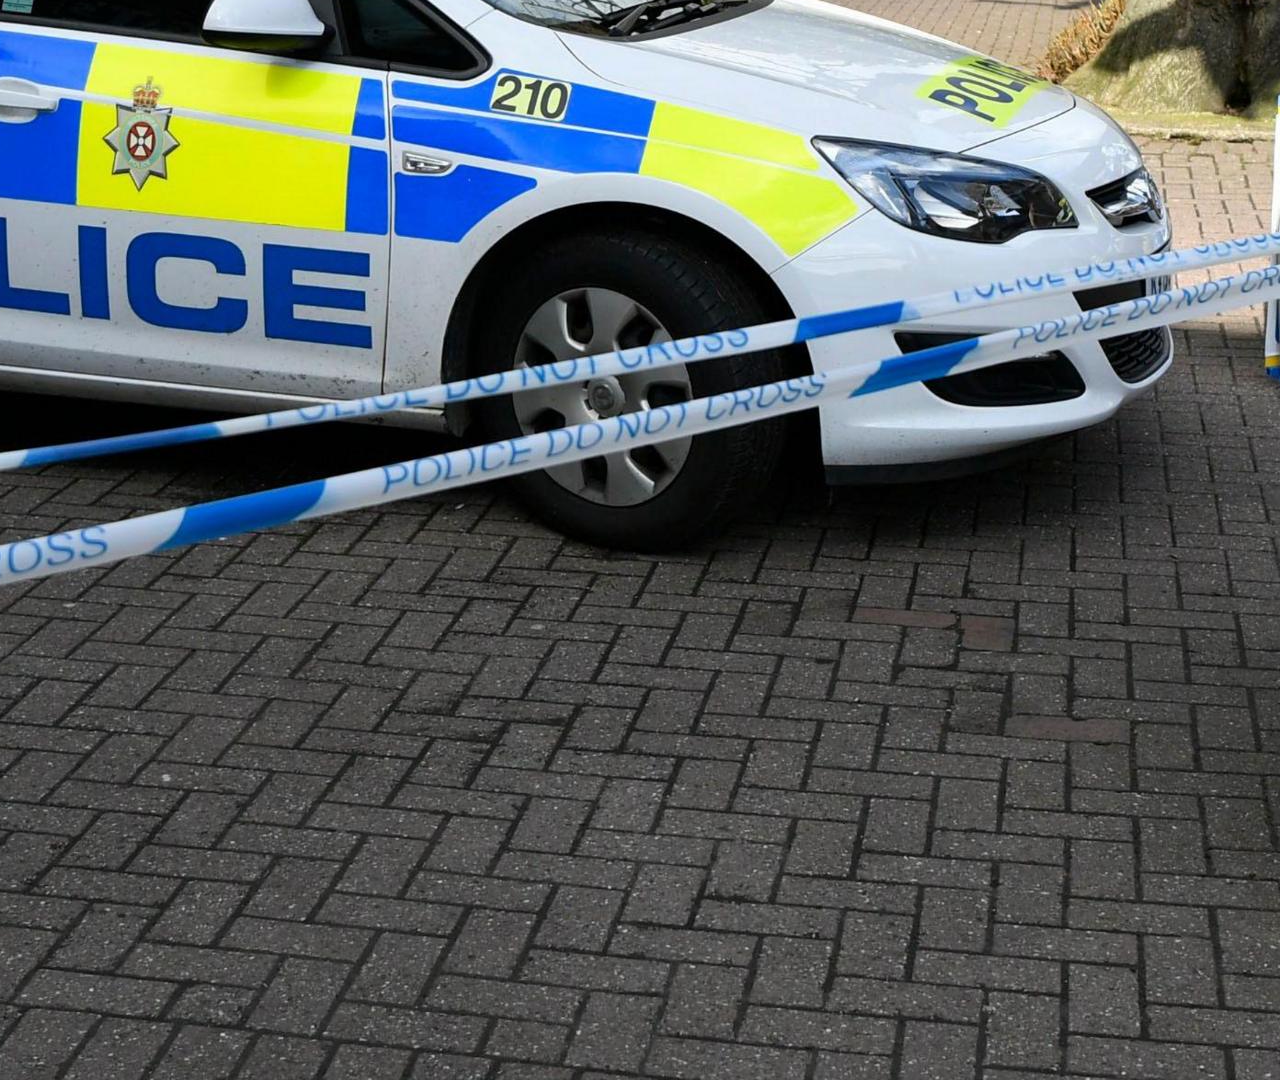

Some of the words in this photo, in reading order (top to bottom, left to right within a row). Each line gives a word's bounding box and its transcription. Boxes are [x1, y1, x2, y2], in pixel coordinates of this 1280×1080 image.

[495, 74, 569, 120] 210
[1013, 304, 1121, 350] POLICE
[1128, 292, 1173, 320] DO
[1176, 275, 1234, 309] NOT
[619, 328, 749, 370] CROSS
[382, 436, 532, 495] POLICE
[546, 421, 604, 458] DO
[615, 403, 688, 443] NOT
[705, 372, 827, 421] CROSS
